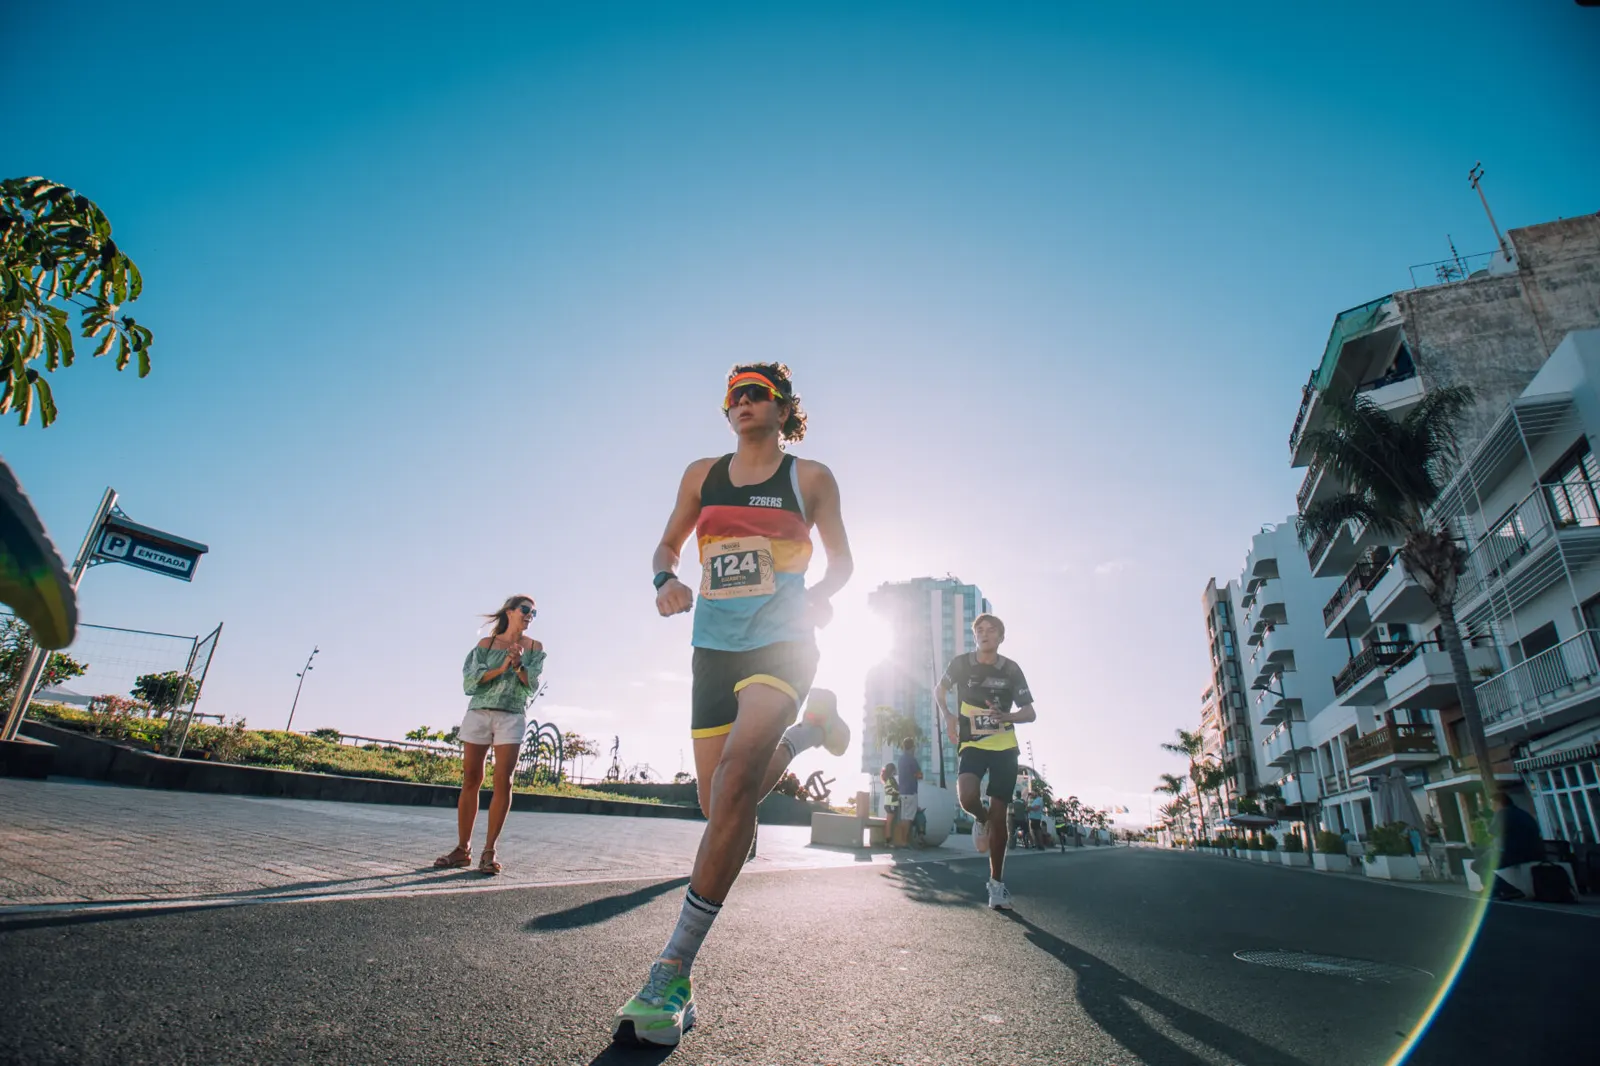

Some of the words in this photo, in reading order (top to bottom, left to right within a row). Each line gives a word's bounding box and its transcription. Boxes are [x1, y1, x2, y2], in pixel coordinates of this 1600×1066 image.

[749, 496, 782, 507] 226ERS
[108, 537, 126, 551] P
[138, 549, 186, 568] ENTRADA
[713, 553, 757, 578] 124
